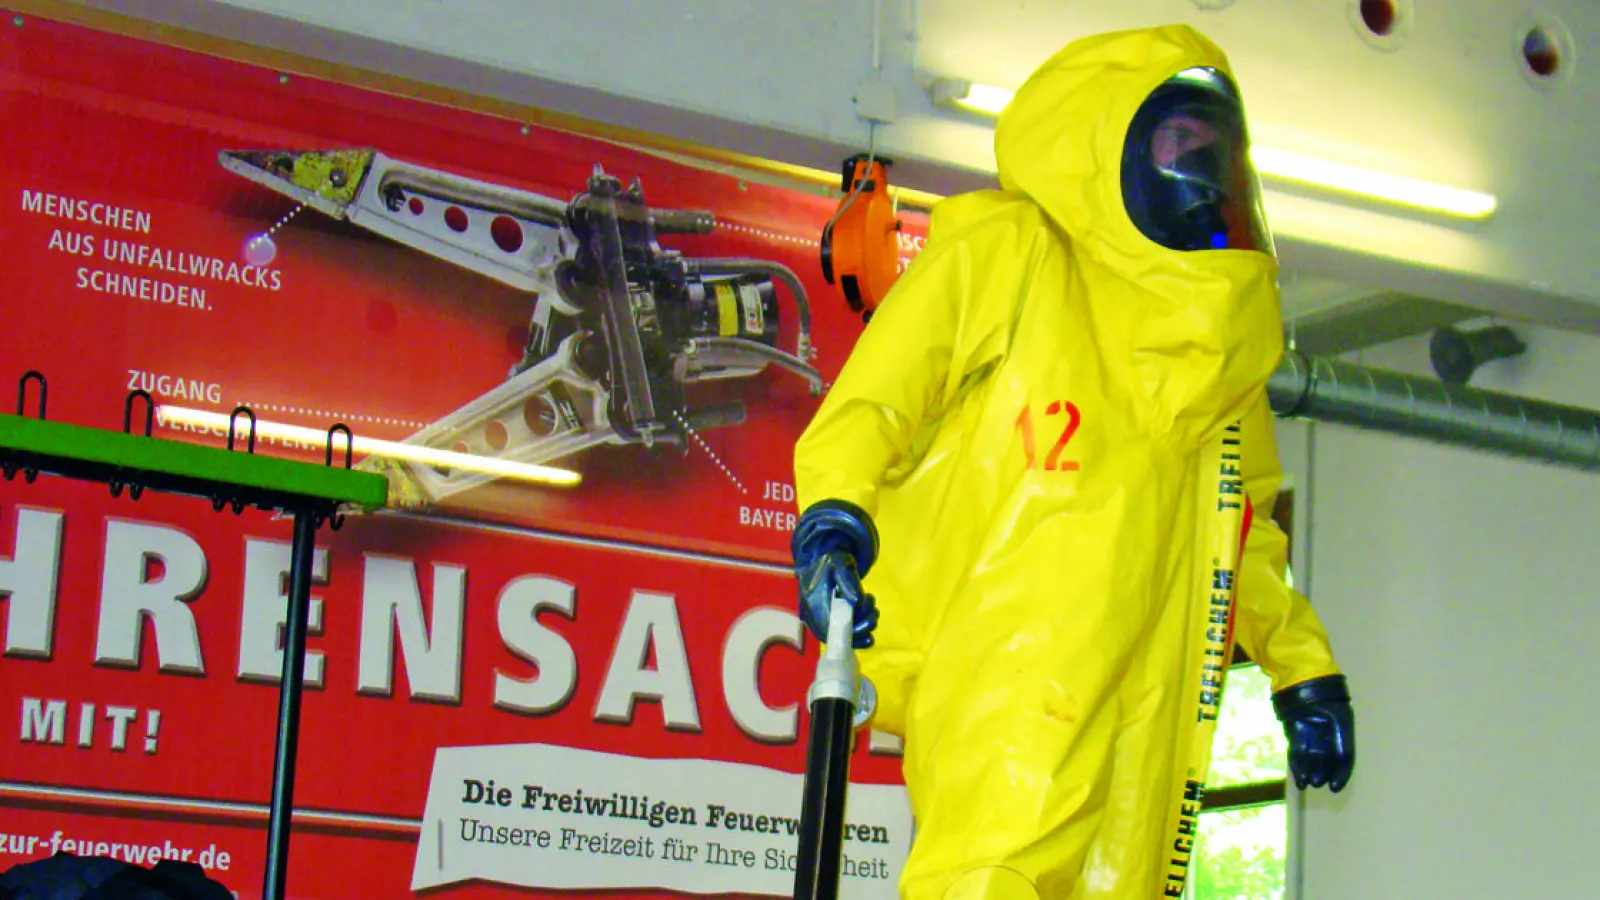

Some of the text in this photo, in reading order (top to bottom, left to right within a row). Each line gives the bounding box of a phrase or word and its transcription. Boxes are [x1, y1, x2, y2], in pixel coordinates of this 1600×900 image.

[22, 189, 151, 234] MENSCHEN
[49, 229, 282, 291] AUS UNFALLWRACKS
[76, 267, 213, 311] SCHNEIDEN.
[127, 369, 222, 404] ZUGANG
[1014, 400, 1081, 471] 12
[0, 503, 903, 756] HRENSAC
[20, 697, 161, 754] MIT!
[462, 779, 890, 844] Die Freiwilligen Feuerwren
[460, 818, 889, 879] Unsere Freizeit für Ihre Sicheit
